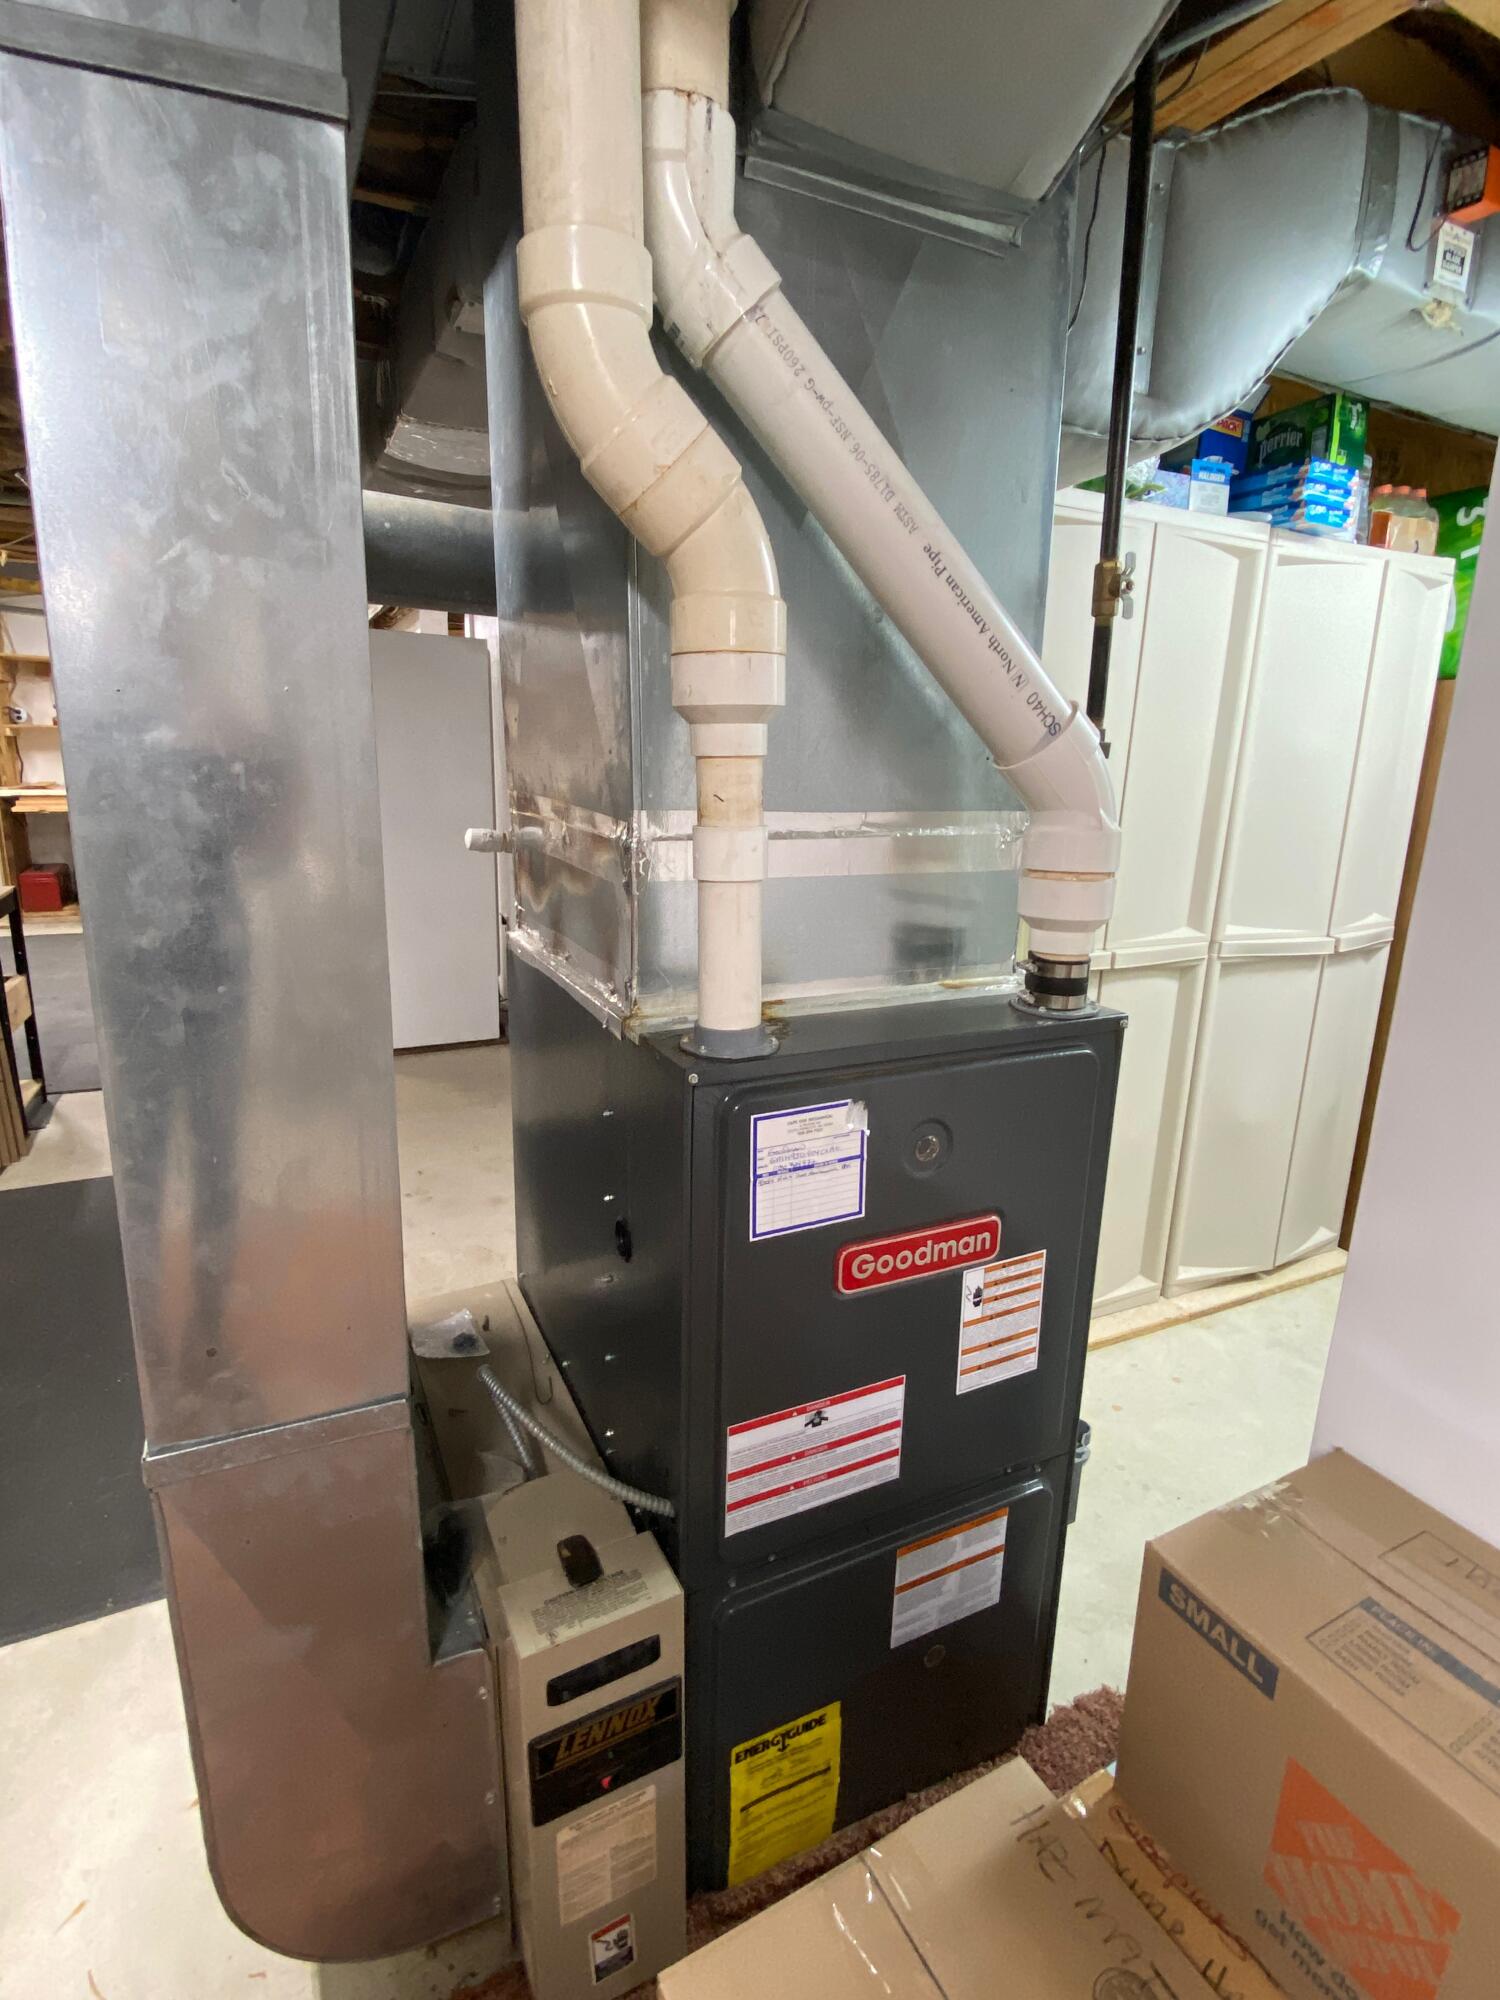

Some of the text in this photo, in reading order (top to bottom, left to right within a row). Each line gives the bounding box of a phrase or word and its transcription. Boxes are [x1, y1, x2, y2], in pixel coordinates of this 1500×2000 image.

[765, 325, 806, 376] 260PSI
[891, 502, 919, 535] ASTM
[920, 540, 948, 577] Pipe
[940, 574, 991, 636] American
[984, 634, 1017, 674] North
[1024, 689, 1062, 737] SCH40
[851, 1231, 991, 1280] Goodman
[1167, 1582, 1266, 1685] SMALL
[556, 1697, 663, 1761] LENNOX
[1268, 1853, 1448, 1940] HOME
[1280, 1909, 1325, 1966] How
